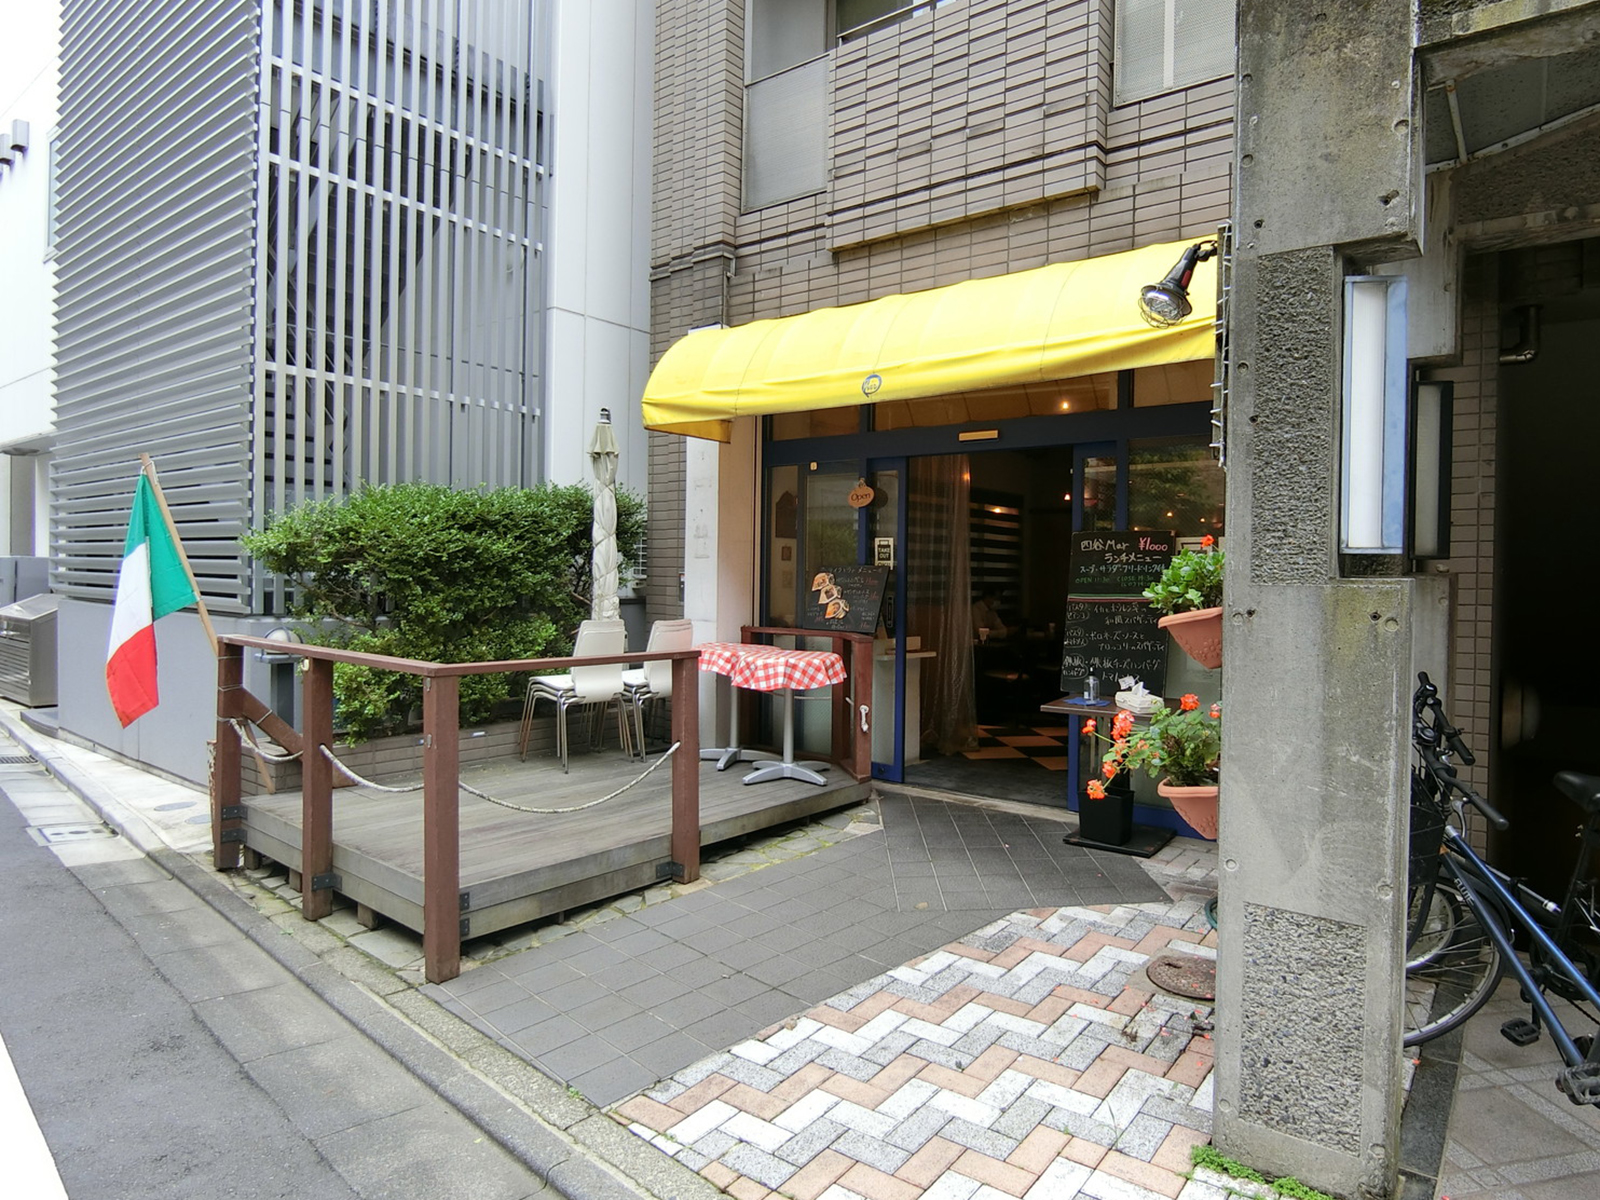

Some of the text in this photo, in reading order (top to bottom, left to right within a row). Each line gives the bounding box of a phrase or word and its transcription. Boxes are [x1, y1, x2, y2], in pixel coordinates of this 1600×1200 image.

[851, 493, 871, 502] Open
[1104, 552, 1162, 564] ランチメニュー
